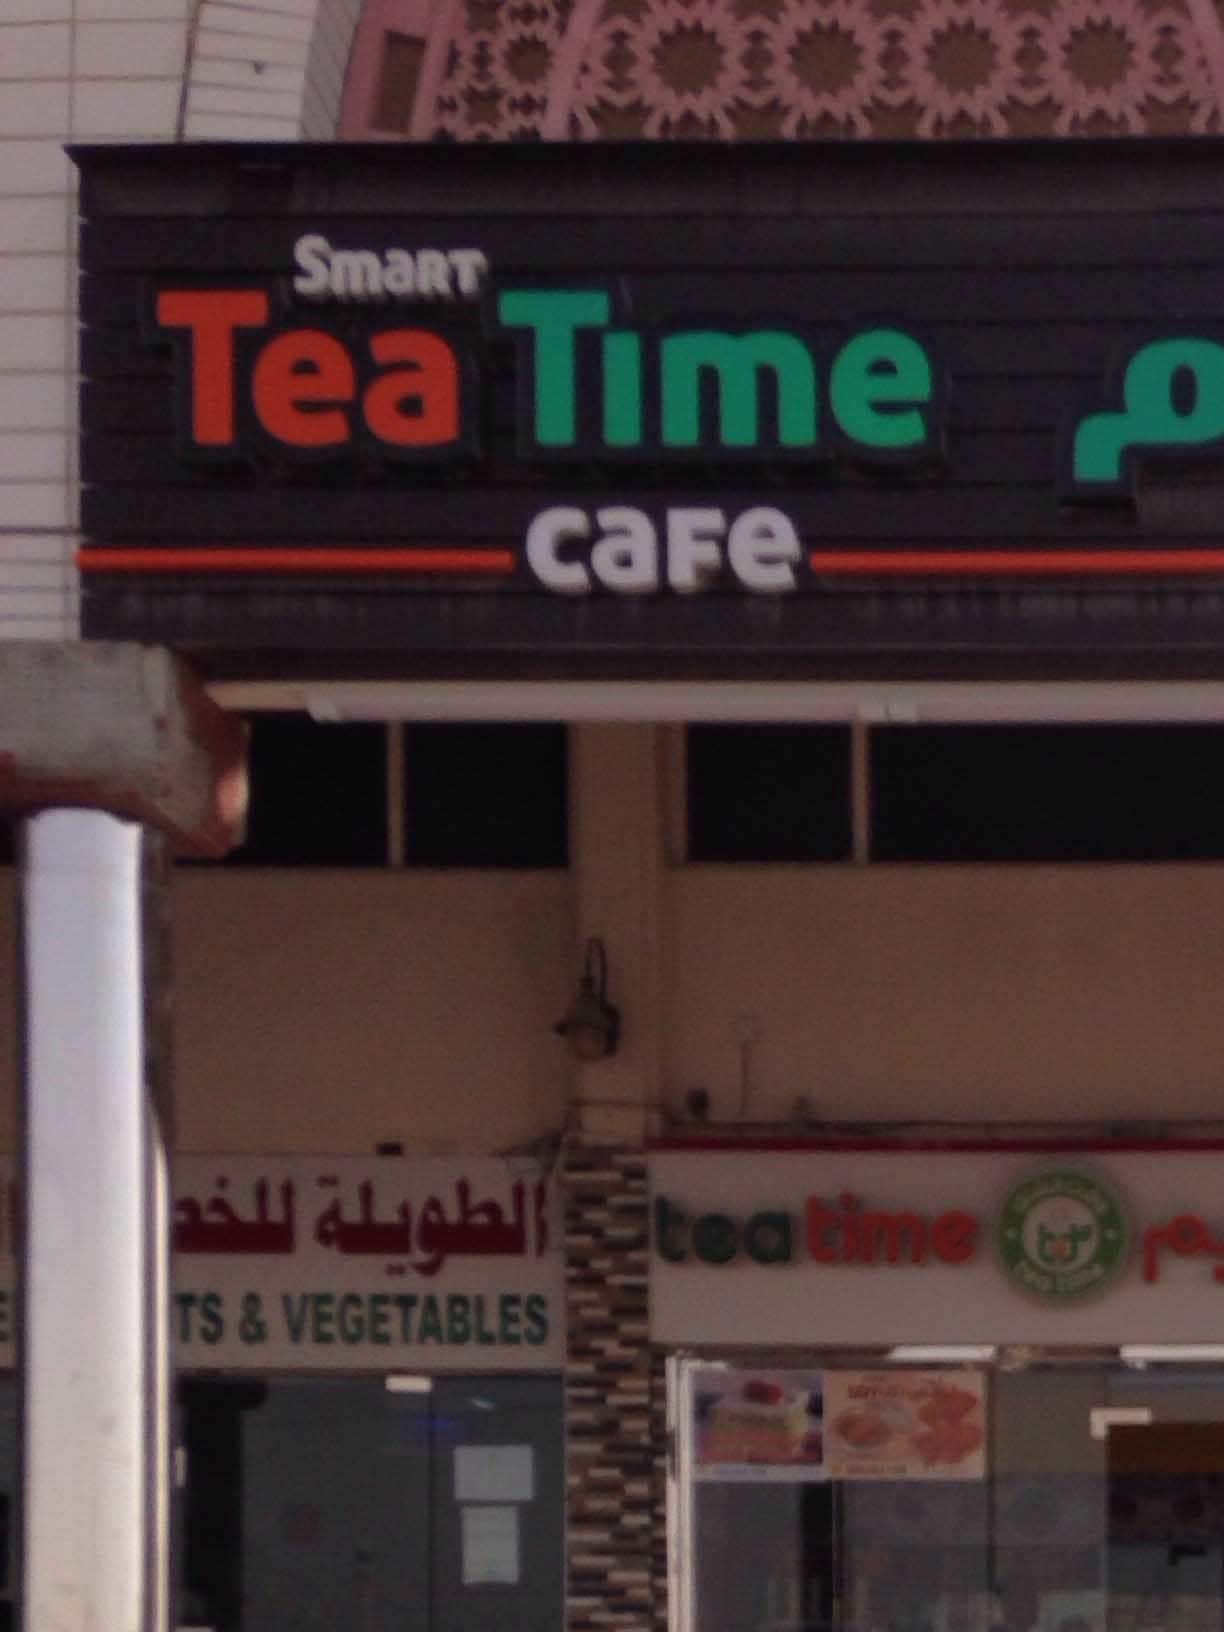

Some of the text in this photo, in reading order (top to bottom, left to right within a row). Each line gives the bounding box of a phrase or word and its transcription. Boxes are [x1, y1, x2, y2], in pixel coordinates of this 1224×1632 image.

[157, 290, 932, 446] Tea Time
[313, 1174, 548, 1277] الطويلة
[655, 1194, 797, 1266] tea
[804, 1189, 980, 1266] time
[238, 1292, 267, 1344] &
[283, 1293, 549, 1345] VEGETABLES
